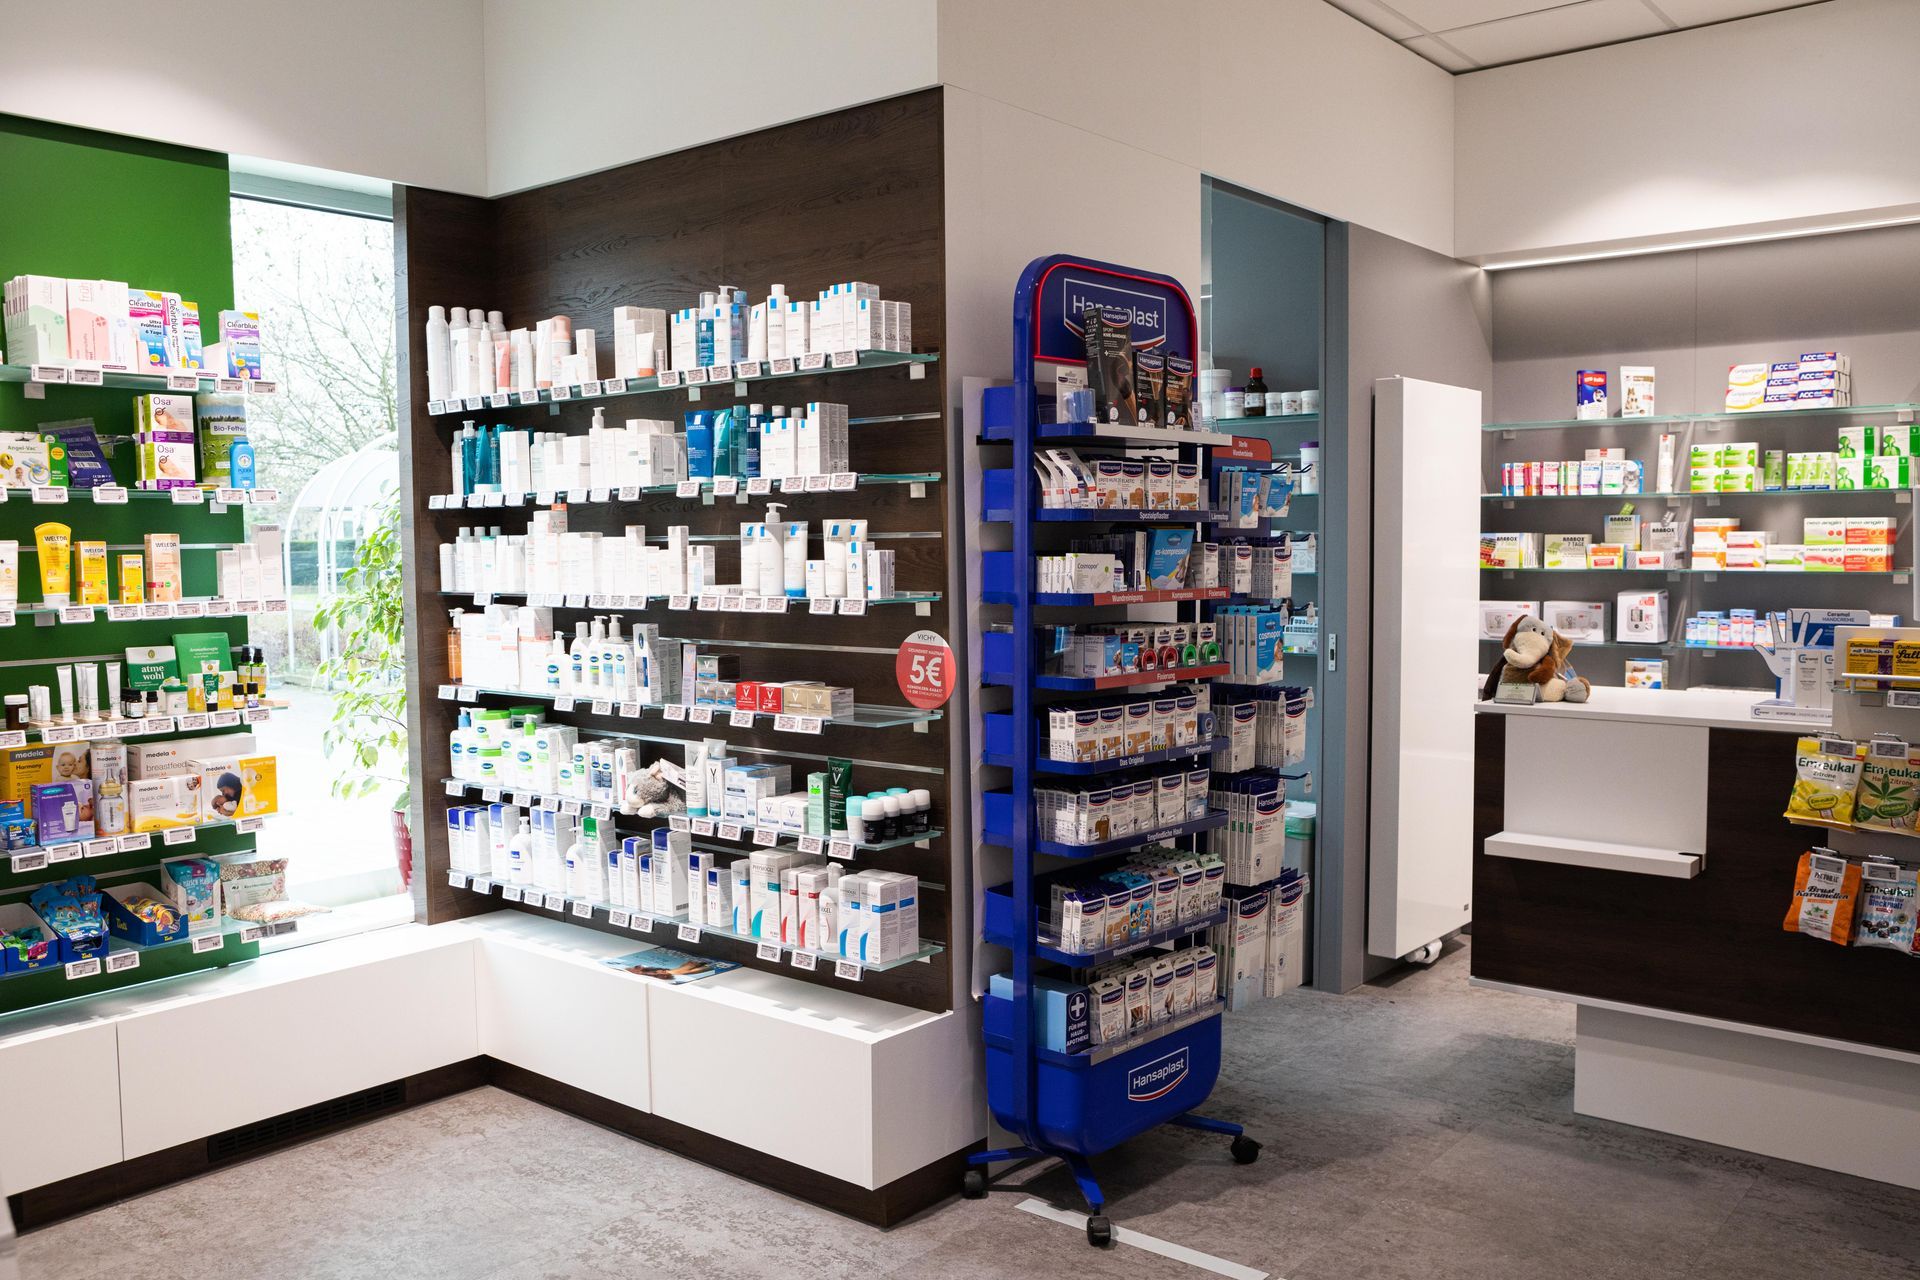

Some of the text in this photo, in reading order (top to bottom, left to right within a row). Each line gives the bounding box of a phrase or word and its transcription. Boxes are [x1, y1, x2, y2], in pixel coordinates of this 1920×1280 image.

[128, 299, 162, 309] Clearblue
[169, 299, 179, 334] Clearblue
[1103, 312, 1129, 324] Hansaplast
[226, 321, 258, 330] Clearblue
[1139, 355, 1162, 368] Hansaplast
[1802, 354, 1816, 362] ACC
[1169, 360, 1192, 373] Hansaplast
[152, 397, 171, 406] Osa
[1765, 394, 1780, 402] ACC
[157, 444, 175, 454] Osa
[1100, 464, 1121, 472] Hansaplast
[1139, 511, 1170, 521] Spezialpflaster
[1610, 514, 1632, 522] ANABOX
[155, 542, 177, 550] WELEDA
[1077, 562, 1099, 571] Cosmopor
[1111, 594, 1144, 603] Wundreinigung
[1171, 591, 1194, 600] Kompresse
[1208, 588, 1227, 599] Fixierung
[917, 633, 937, 642] VICHY
[1258, 631, 1282, 642] cosmopor
[141, 665, 164, 673] atme
[910, 655, 942, 687] 5€
[143, 672, 165, 681] wohl
[1156, 671, 1176, 681] Fixierung
[1101, 709, 1122, 719] Hansaplast
[1130, 704, 1150, 715] Hansaplast
[1077, 713, 1099, 723] Hansaplast
[1126, 719, 1140, 727] CLASSIC
[15, 750, 44, 760] medela
[146, 751, 170, 759] medela
[1119, 755, 1145, 767] Das Original
[1798, 757, 1857, 774] Em-eukal
[16, 762, 42, 772] Harmony
[833, 773, 842, 785] V
[1812, 771, 1837, 779] Zitrone
[1890, 778, 1913, 786] Zitrone
[140, 795, 155, 803] quick
[1090, 793, 1111, 802] Hansaplast
[1147, 827, 1183, 843] Empfindliche Haut
[753, 864, 775, 873] PHYSIOGEL
[1796, 889, 1849, 900] Karamellen
[1807, 885, 1835, 895] Brust
[1864, 882, 1914, 898] Em-eukal
[1082, 901, 1105, 914] Hansaplast
[1241, 896, 1267, 912] Hansaplast
[1068, 1020, 1088, 1032] FÜR IHRE
[1070, 1029, 1085, 1038] HAUS-
[1066, 1033, 1090, 1047] APOTHEKE
[1132, 1057, 1185, 1091] Hansaplast
